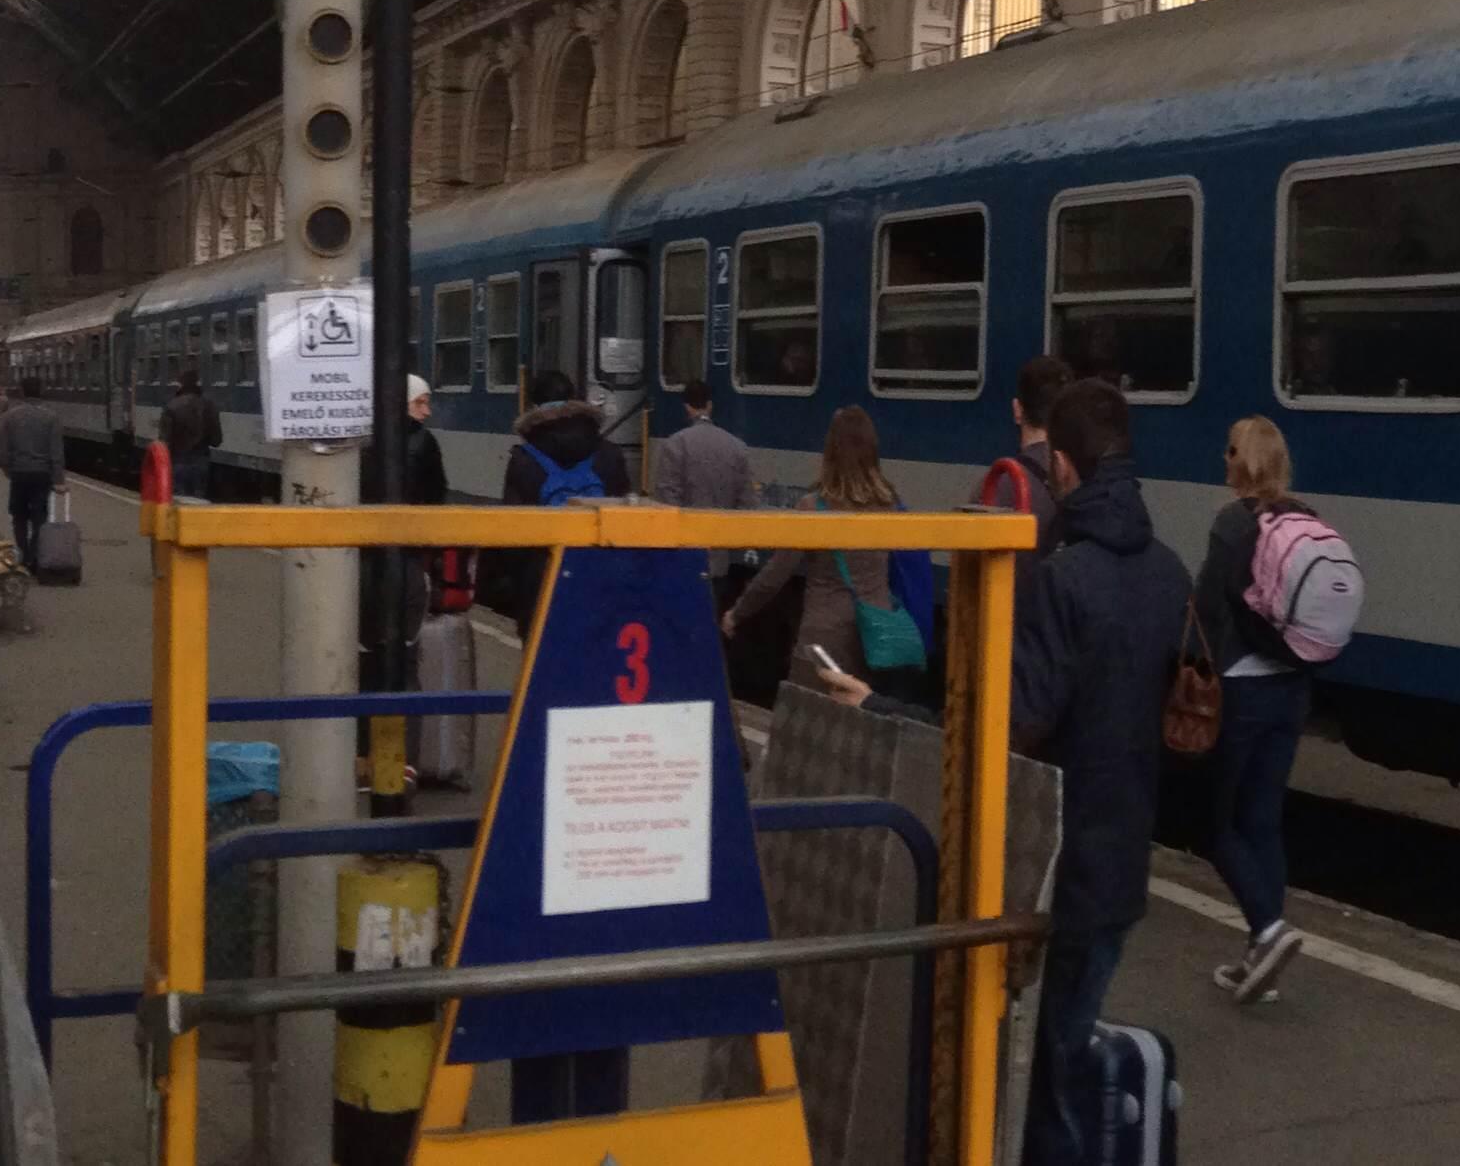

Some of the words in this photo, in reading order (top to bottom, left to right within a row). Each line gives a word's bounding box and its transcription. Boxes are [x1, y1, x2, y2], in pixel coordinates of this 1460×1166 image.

[717, 251, 728, 284] 2
[310, 372, 351, 384] MOBIL
[616, 622, 650, 705] 3
